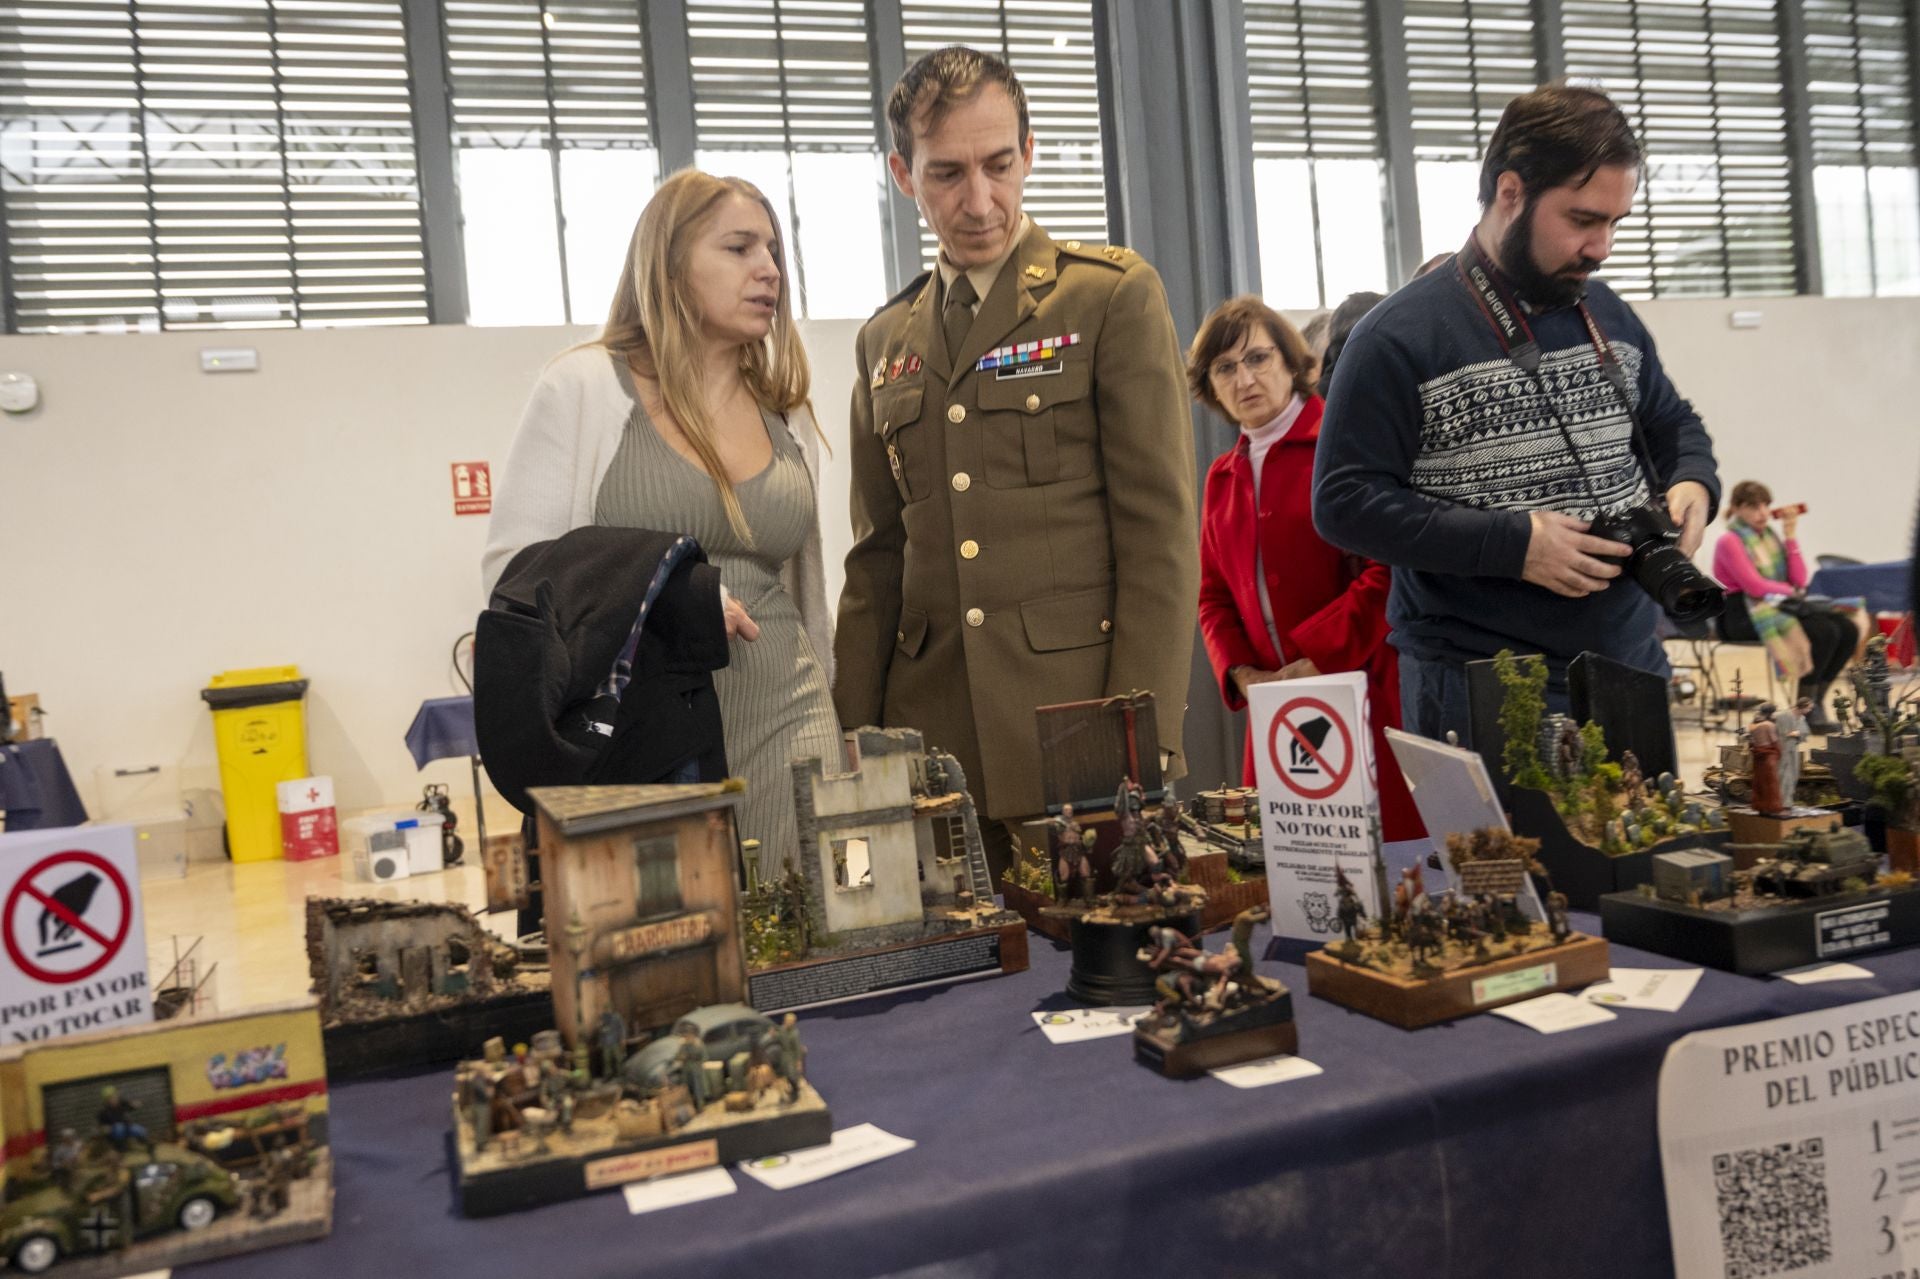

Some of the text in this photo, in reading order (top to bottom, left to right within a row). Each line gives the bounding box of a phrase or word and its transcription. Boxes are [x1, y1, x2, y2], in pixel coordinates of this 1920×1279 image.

[1470, 266, 1518, 338] EOS DIGITAL
[1269, 801, 1303, 816] POR
[1307, 804, 1364, 819] FAVOR
[1276, 821, 1361, 839] NO TOCAR
[1, 971, 147, 1024] POR FAVOR
[12, 998, 142, 1042] NO TOCAR
[1724, 1011, 1920, 1075] PREMIO ESPEC
[1766, 1052, 1919, 1108] DEL PÚBLIC
[1870, 1120, 1883, 1154] 1
[1873, 1168, 1892, 1201] 2
[1877, 1215, 1895, 1255] 3
